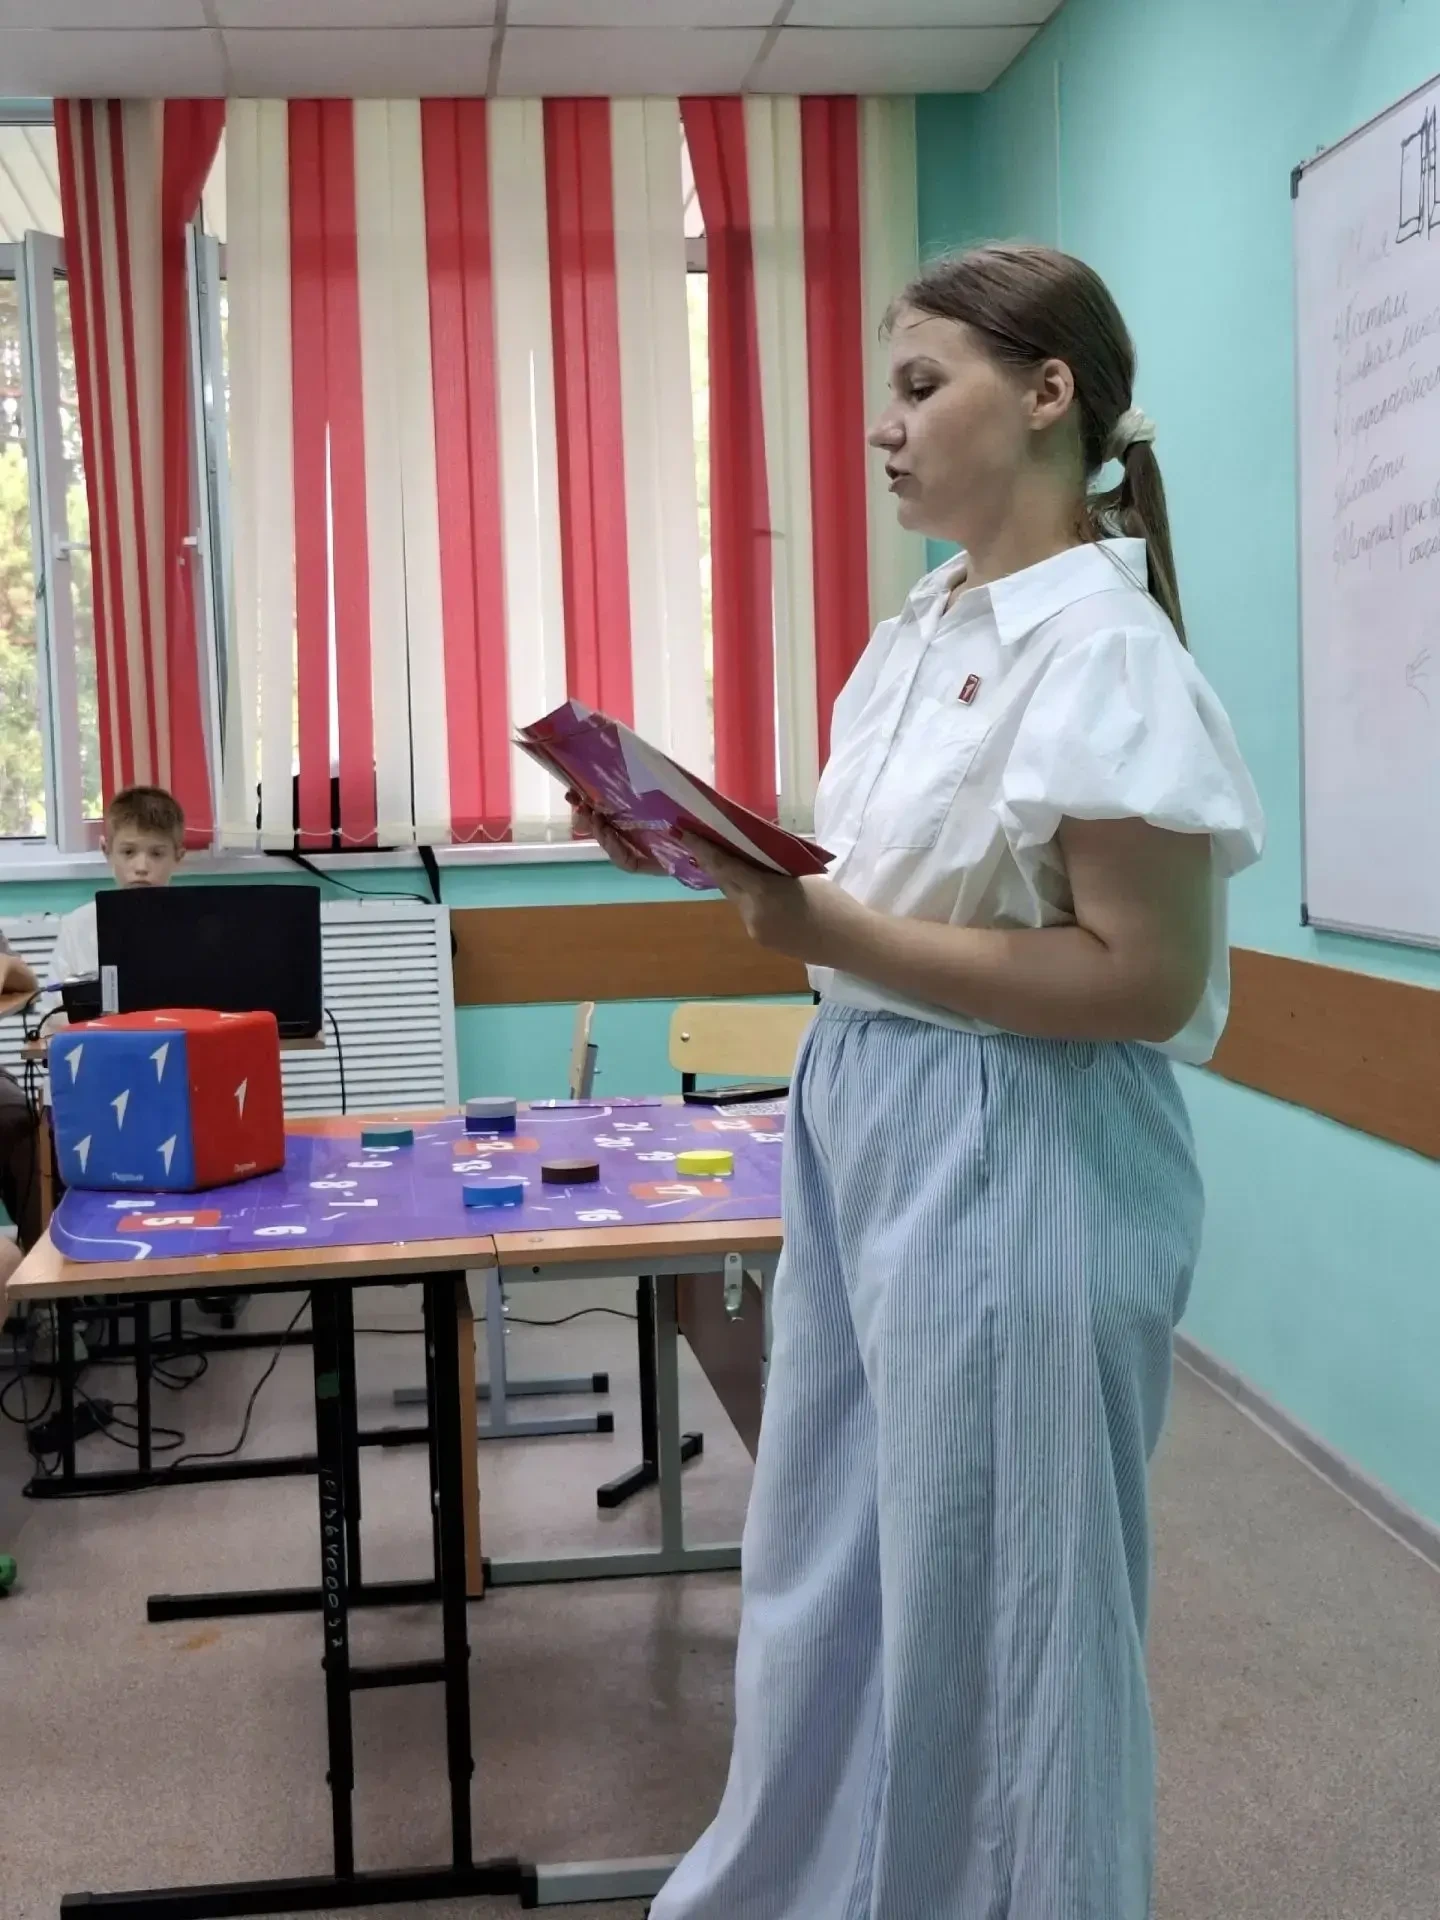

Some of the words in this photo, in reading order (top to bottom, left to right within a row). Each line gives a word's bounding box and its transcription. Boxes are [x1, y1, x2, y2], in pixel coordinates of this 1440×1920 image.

[613, 1122, 653, 1132] 21
[711, 1119, 753, 1130] 22
[476, 1141, 514, 1151] 12
[635, 1151, 677, 1162] 19
[347, 1160, 393, 1169] 9
[452, 1160, 491, 1172] 13
[310, 1180, 358, 1189] 8
[654, 1185, 702, 1197] 17
[107, 1199, 156, 1209] 4
[329, 1198, 379, 1208] 7
[575, 1209, 624, 1222] 16
[142, 1216, 195, 1226] 5
[254, 1225, 307, 1236] 6
